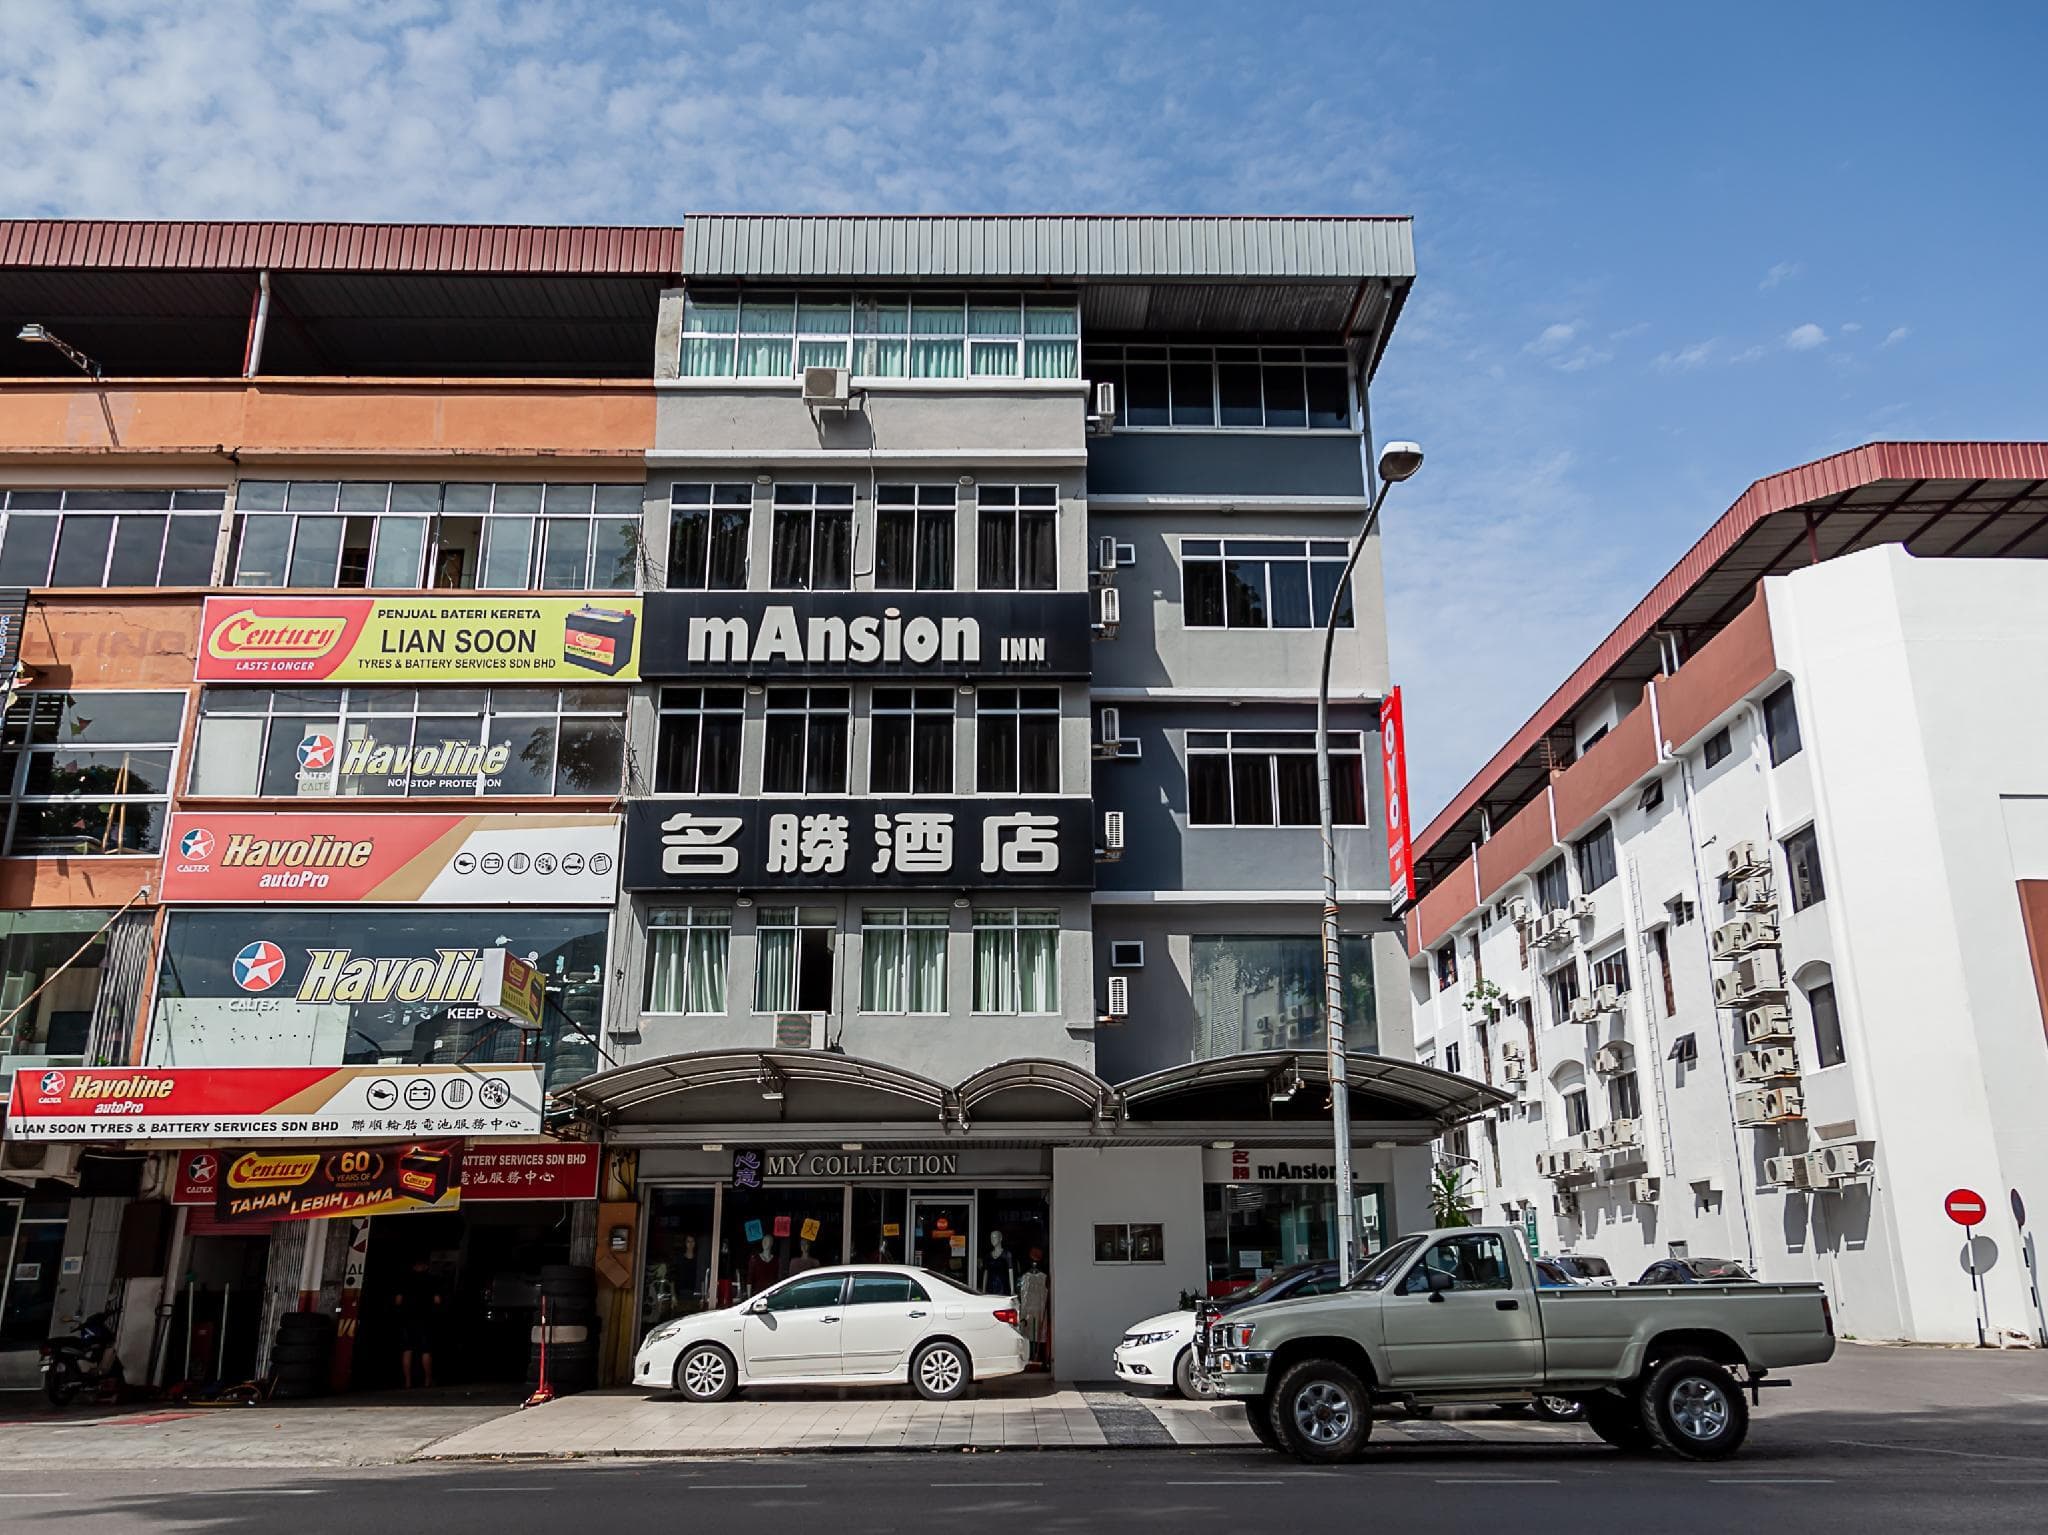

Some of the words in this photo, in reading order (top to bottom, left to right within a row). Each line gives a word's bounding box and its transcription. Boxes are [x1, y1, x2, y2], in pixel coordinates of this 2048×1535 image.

[377, 609, 437, 620] PENJUAL
[441, 609, 487, 620] BATERI
[490, 608, 541, 620] KERETA
[218, 618, 338, 653] Century
[381, 630, 449, 653] LIAN
[455, 629, 536, 653] SOON
[687, 605, 980, 664] mAnsion
[1000, 637, 1046, 662] INN
[235, 661, 269, 672] LASTS
[271, 660, 315, 672] LONGER
[358, 659, 392, 670] TYRES
[394, 659, 403, 669] &
[405, 659, 453, 669] BATTERY
[455, 659, 508, 669] SERVICES
[509, 658, 532, 669] SDN
[534, 658, 556, 669] BHD
[340, 738, 510, 777] Havoline
[438, 778, 502, 788] PROTECION
[1385, 718, 1400, 830] OYO
[221, 834, 374, 868] Havoline
[660, 812, 1060, 875] 名勝酒店
[176, 864, 211, 873] CALTEX
[259, 872, 330, 889] autoPro
[228, 999, 280, 1013] CALTEX
[447, 1007, 484, 1019] KEEP
[69, 1075, 175, 1099] Havoline
[95, 1101, 144, 1114] autoPro
[14, 1124, 46, 1134] LIAN
[48, 1123, 86, 1134] SOON
[90, 1123, 133, 1133] TYRES
[137, 1123, 146, 1133] &
[150, 1122, 211, 1133] BATTERY
[214, 1122, 277, 1132] SERVICES
[281, 1121, 307, 1131] SDN
[311, 1121, 339, 1131] BHD
[341, 1151, 370, 1173] 60
[461, 1155, 496, 1166] ATTERY
[499, 1154, 544, 1165] SERVICES
[546, 1154, 565, 1164] SDN
[567, 1153, 587, 1164] BHD
[767, 1153, 806, 1176] MY
[810, 1155, 957, 1176] COLLECTION
[234, 1157, 313, 1183] Century
[336, 1173, 360, 1182] YEARS
[361, 1172, 371, 1181] OF
[230, 1190, 293, 1215] TAHAN
[290, 1191, 343, 1214] LEBIH
[342, 1187, 393, 1210] LAMA
